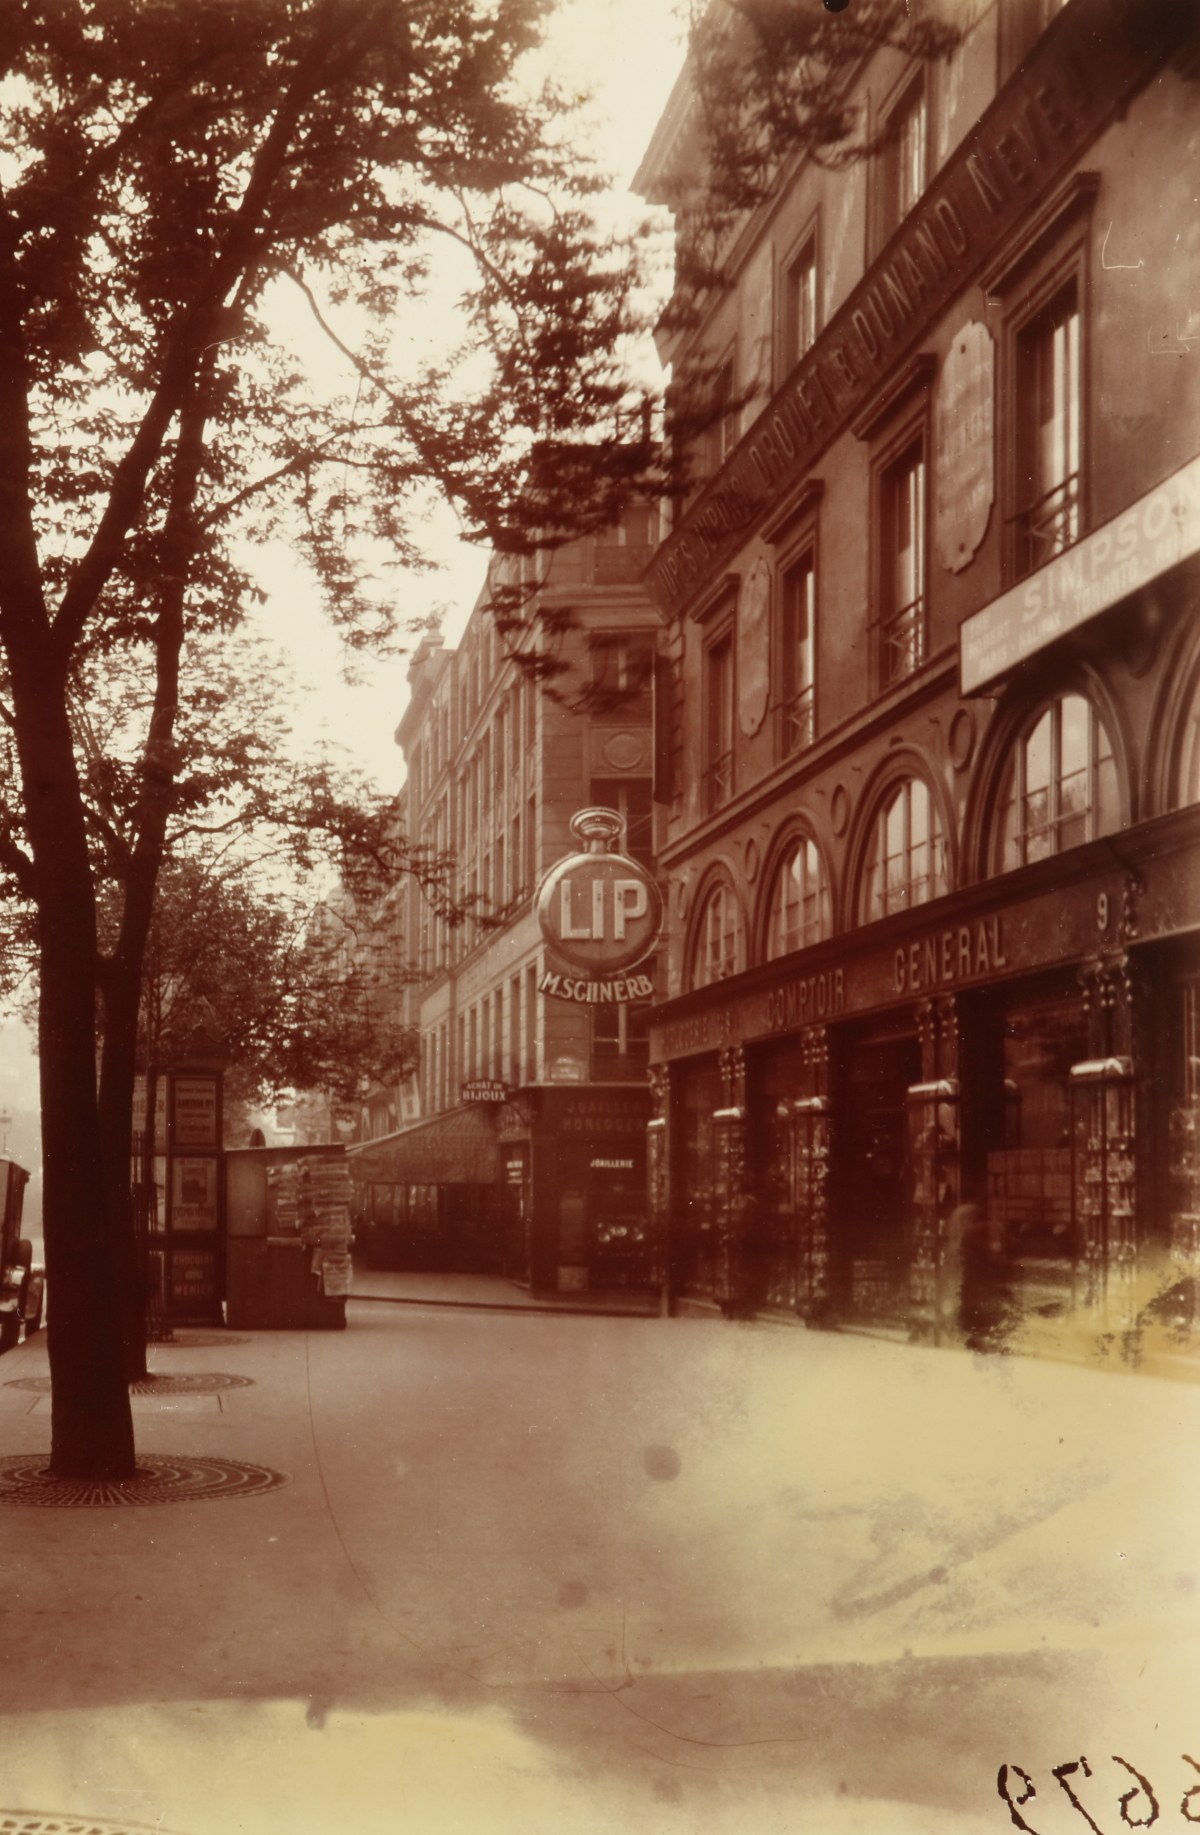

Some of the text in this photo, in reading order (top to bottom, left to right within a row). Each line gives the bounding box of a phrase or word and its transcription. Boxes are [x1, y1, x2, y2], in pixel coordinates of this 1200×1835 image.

[747, 362, 839, 489] DROUET
[850, 195, 967, 361] DUNAND
[1022, 466, 1200, 623] SIMPSON
[561, 879, 648, 940] LIP
[1096, 892, 1109, 932] 9
[767, 916, 1007, 1030] COMPTOIR GENERAL
[462, 1090, 506, 1102] BIJOUX
[466, 1081, 493, 1090] ACHAT
[590, 1158, 634, 1168] JOAILLERIE
[173, 1255, 214, 1266] CHOCOLAT
[174, 1285, 213, 1296] MENIER
